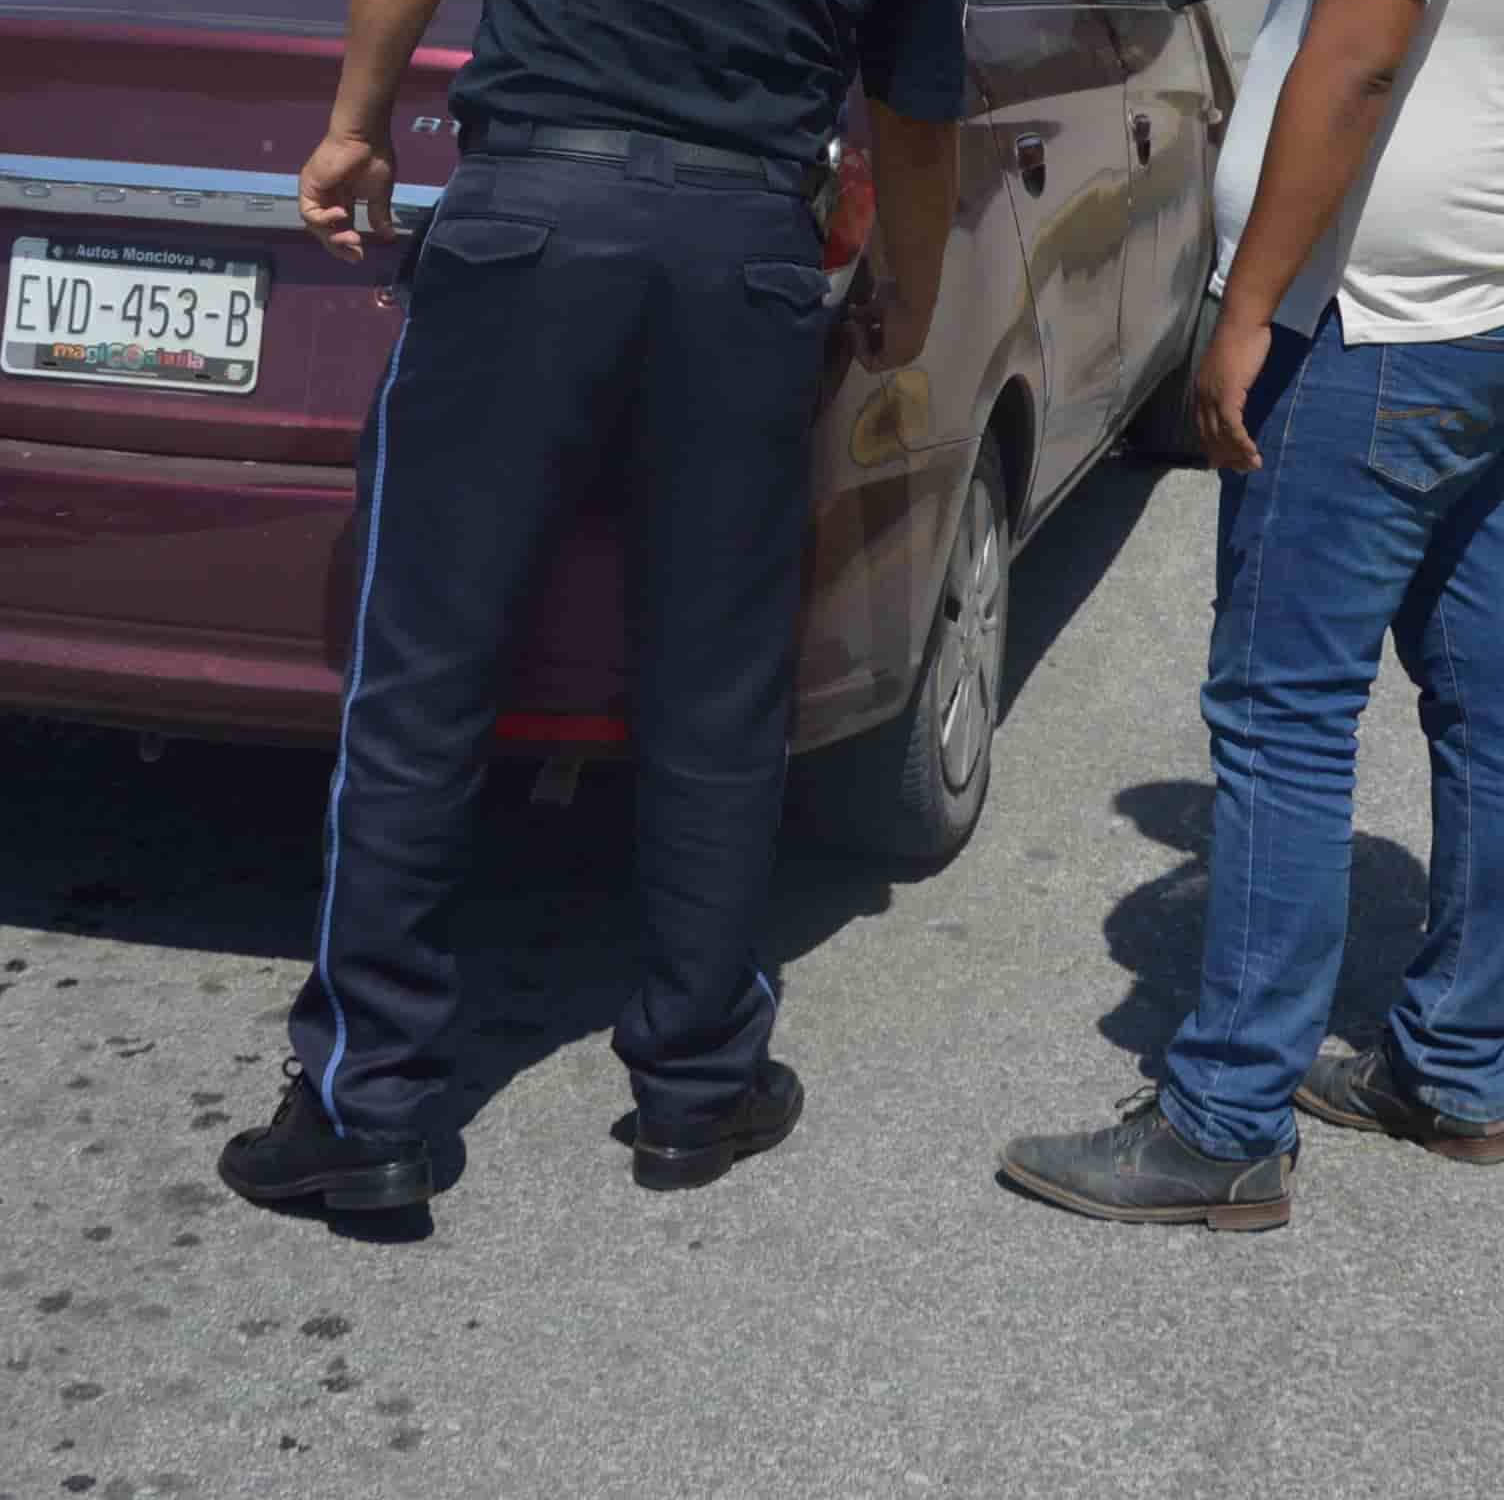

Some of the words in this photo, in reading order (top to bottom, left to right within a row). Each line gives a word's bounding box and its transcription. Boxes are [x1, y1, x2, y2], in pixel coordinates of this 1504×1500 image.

[76, 243, 119, 260] Autos
[122, 246, 195, 266] Monclova
[15, 273, 252, 348] EVD-453-B
